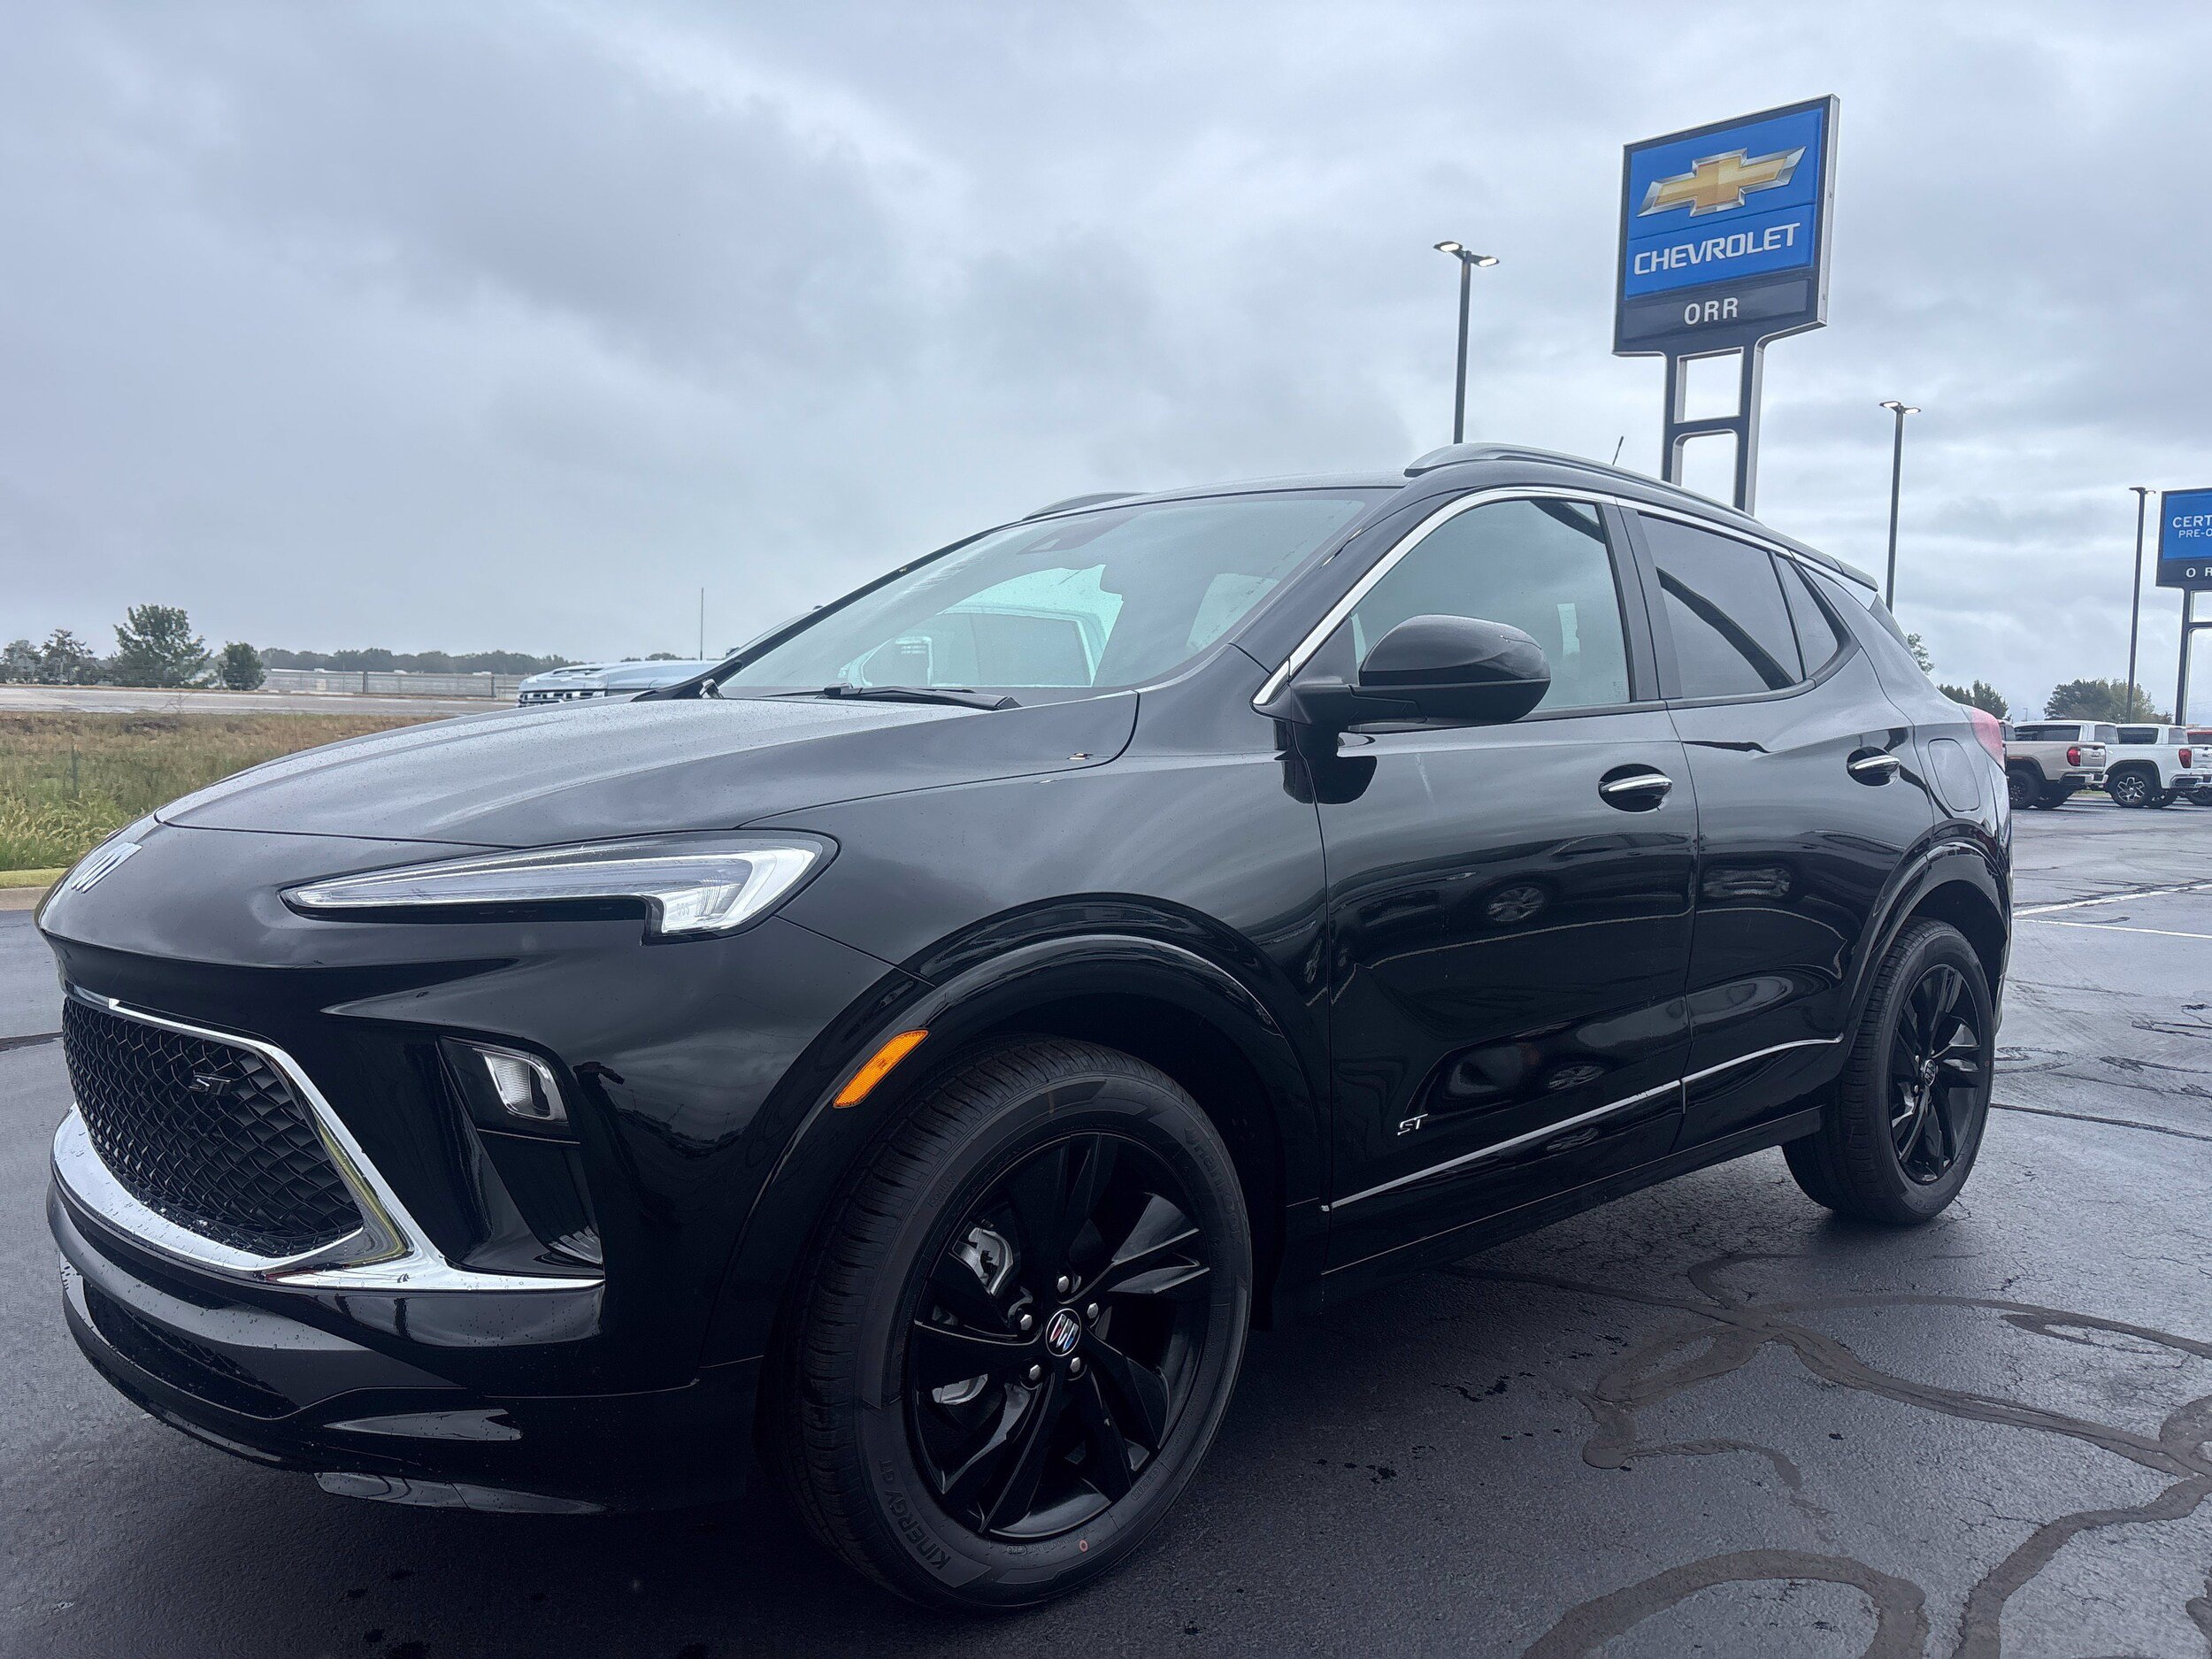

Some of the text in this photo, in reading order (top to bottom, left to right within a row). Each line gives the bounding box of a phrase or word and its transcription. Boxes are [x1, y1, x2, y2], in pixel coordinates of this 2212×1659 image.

[1633, 222, 1801, 275] CHEVROLET
[1684, 296, 1739, 326] ORR
[2172, 515, 2212, 528] CERT
[1397, 1114, 1428, 1136] ST
[884, 1489, 952, 1571] KINERGY
